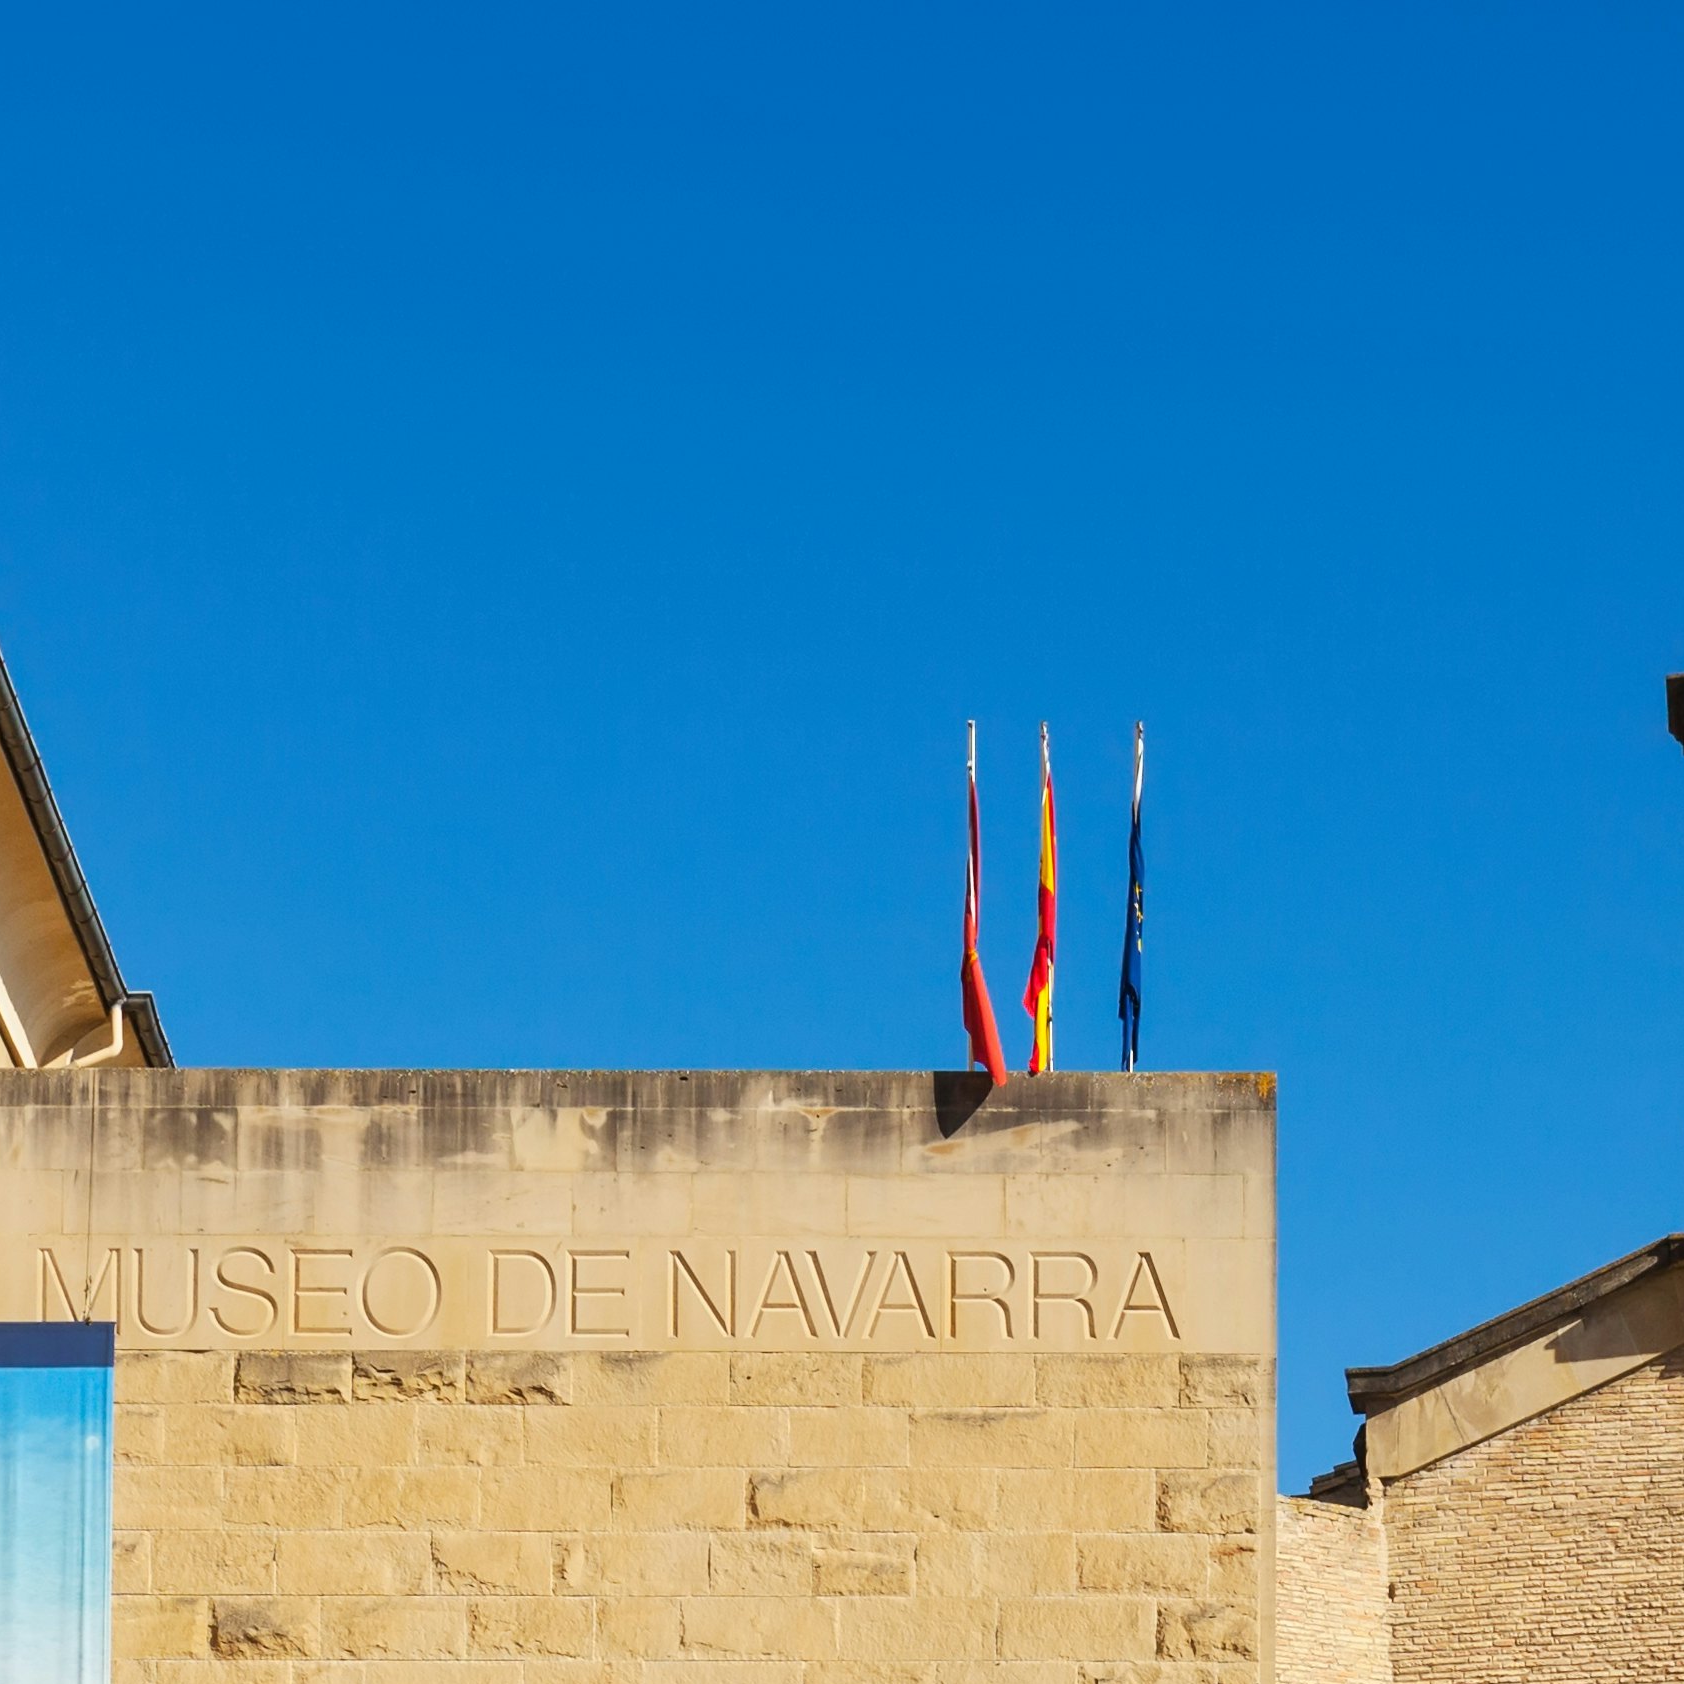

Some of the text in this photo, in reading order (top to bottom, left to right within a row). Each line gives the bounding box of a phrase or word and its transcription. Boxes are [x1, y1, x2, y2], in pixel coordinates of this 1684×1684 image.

[36, 1246, 1180, 1340] MUSEO DE NAVARRA
